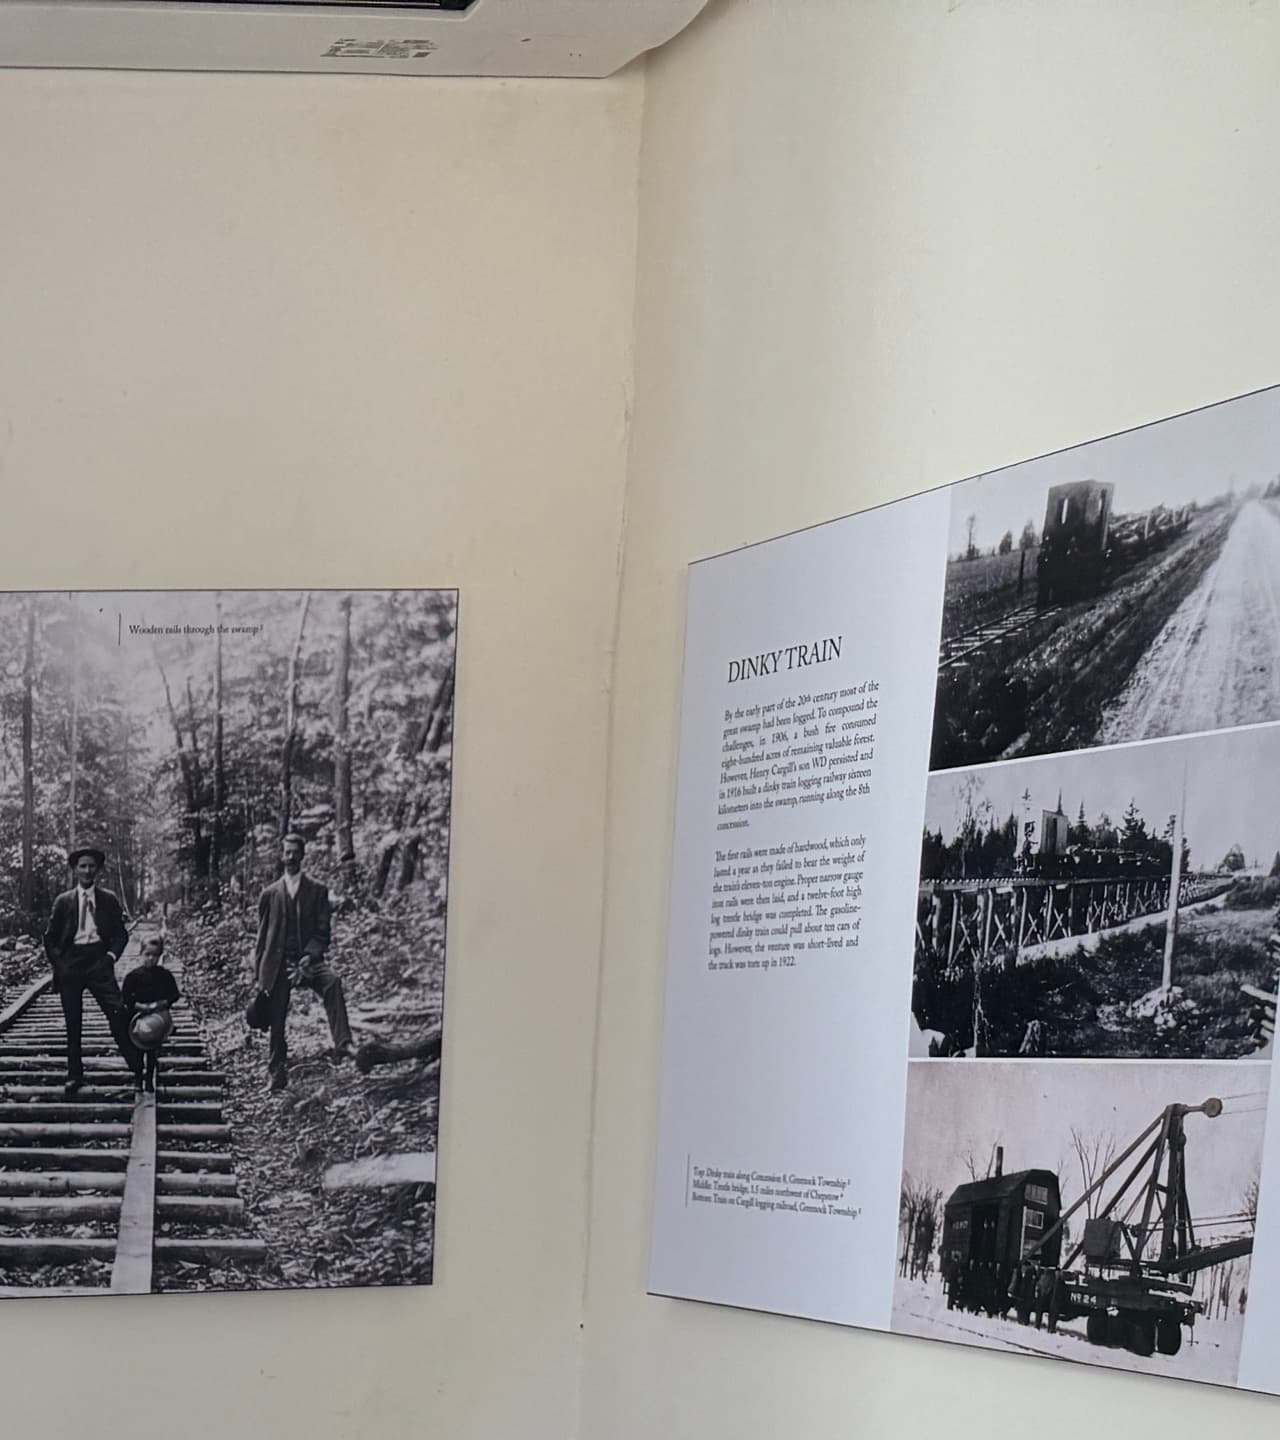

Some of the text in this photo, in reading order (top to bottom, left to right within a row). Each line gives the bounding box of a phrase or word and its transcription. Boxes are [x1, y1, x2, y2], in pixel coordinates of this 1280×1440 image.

[129, 625, 163, 635] Wooden
[165, 624, 182, 635] rails
[183, 624, 214, 636] through
[217, 624, 229, 634] the
[727, 636, 842, 683] DINKY TRAIN
[813, 691, 838, 704] century
[868, 680, 879, 692] the
[828, 699, 865, 718] compound
[812, 755, 827, 769] WD
[815, 904, 828, 917] The
[1084, 1295, 1097, 1305] 24
